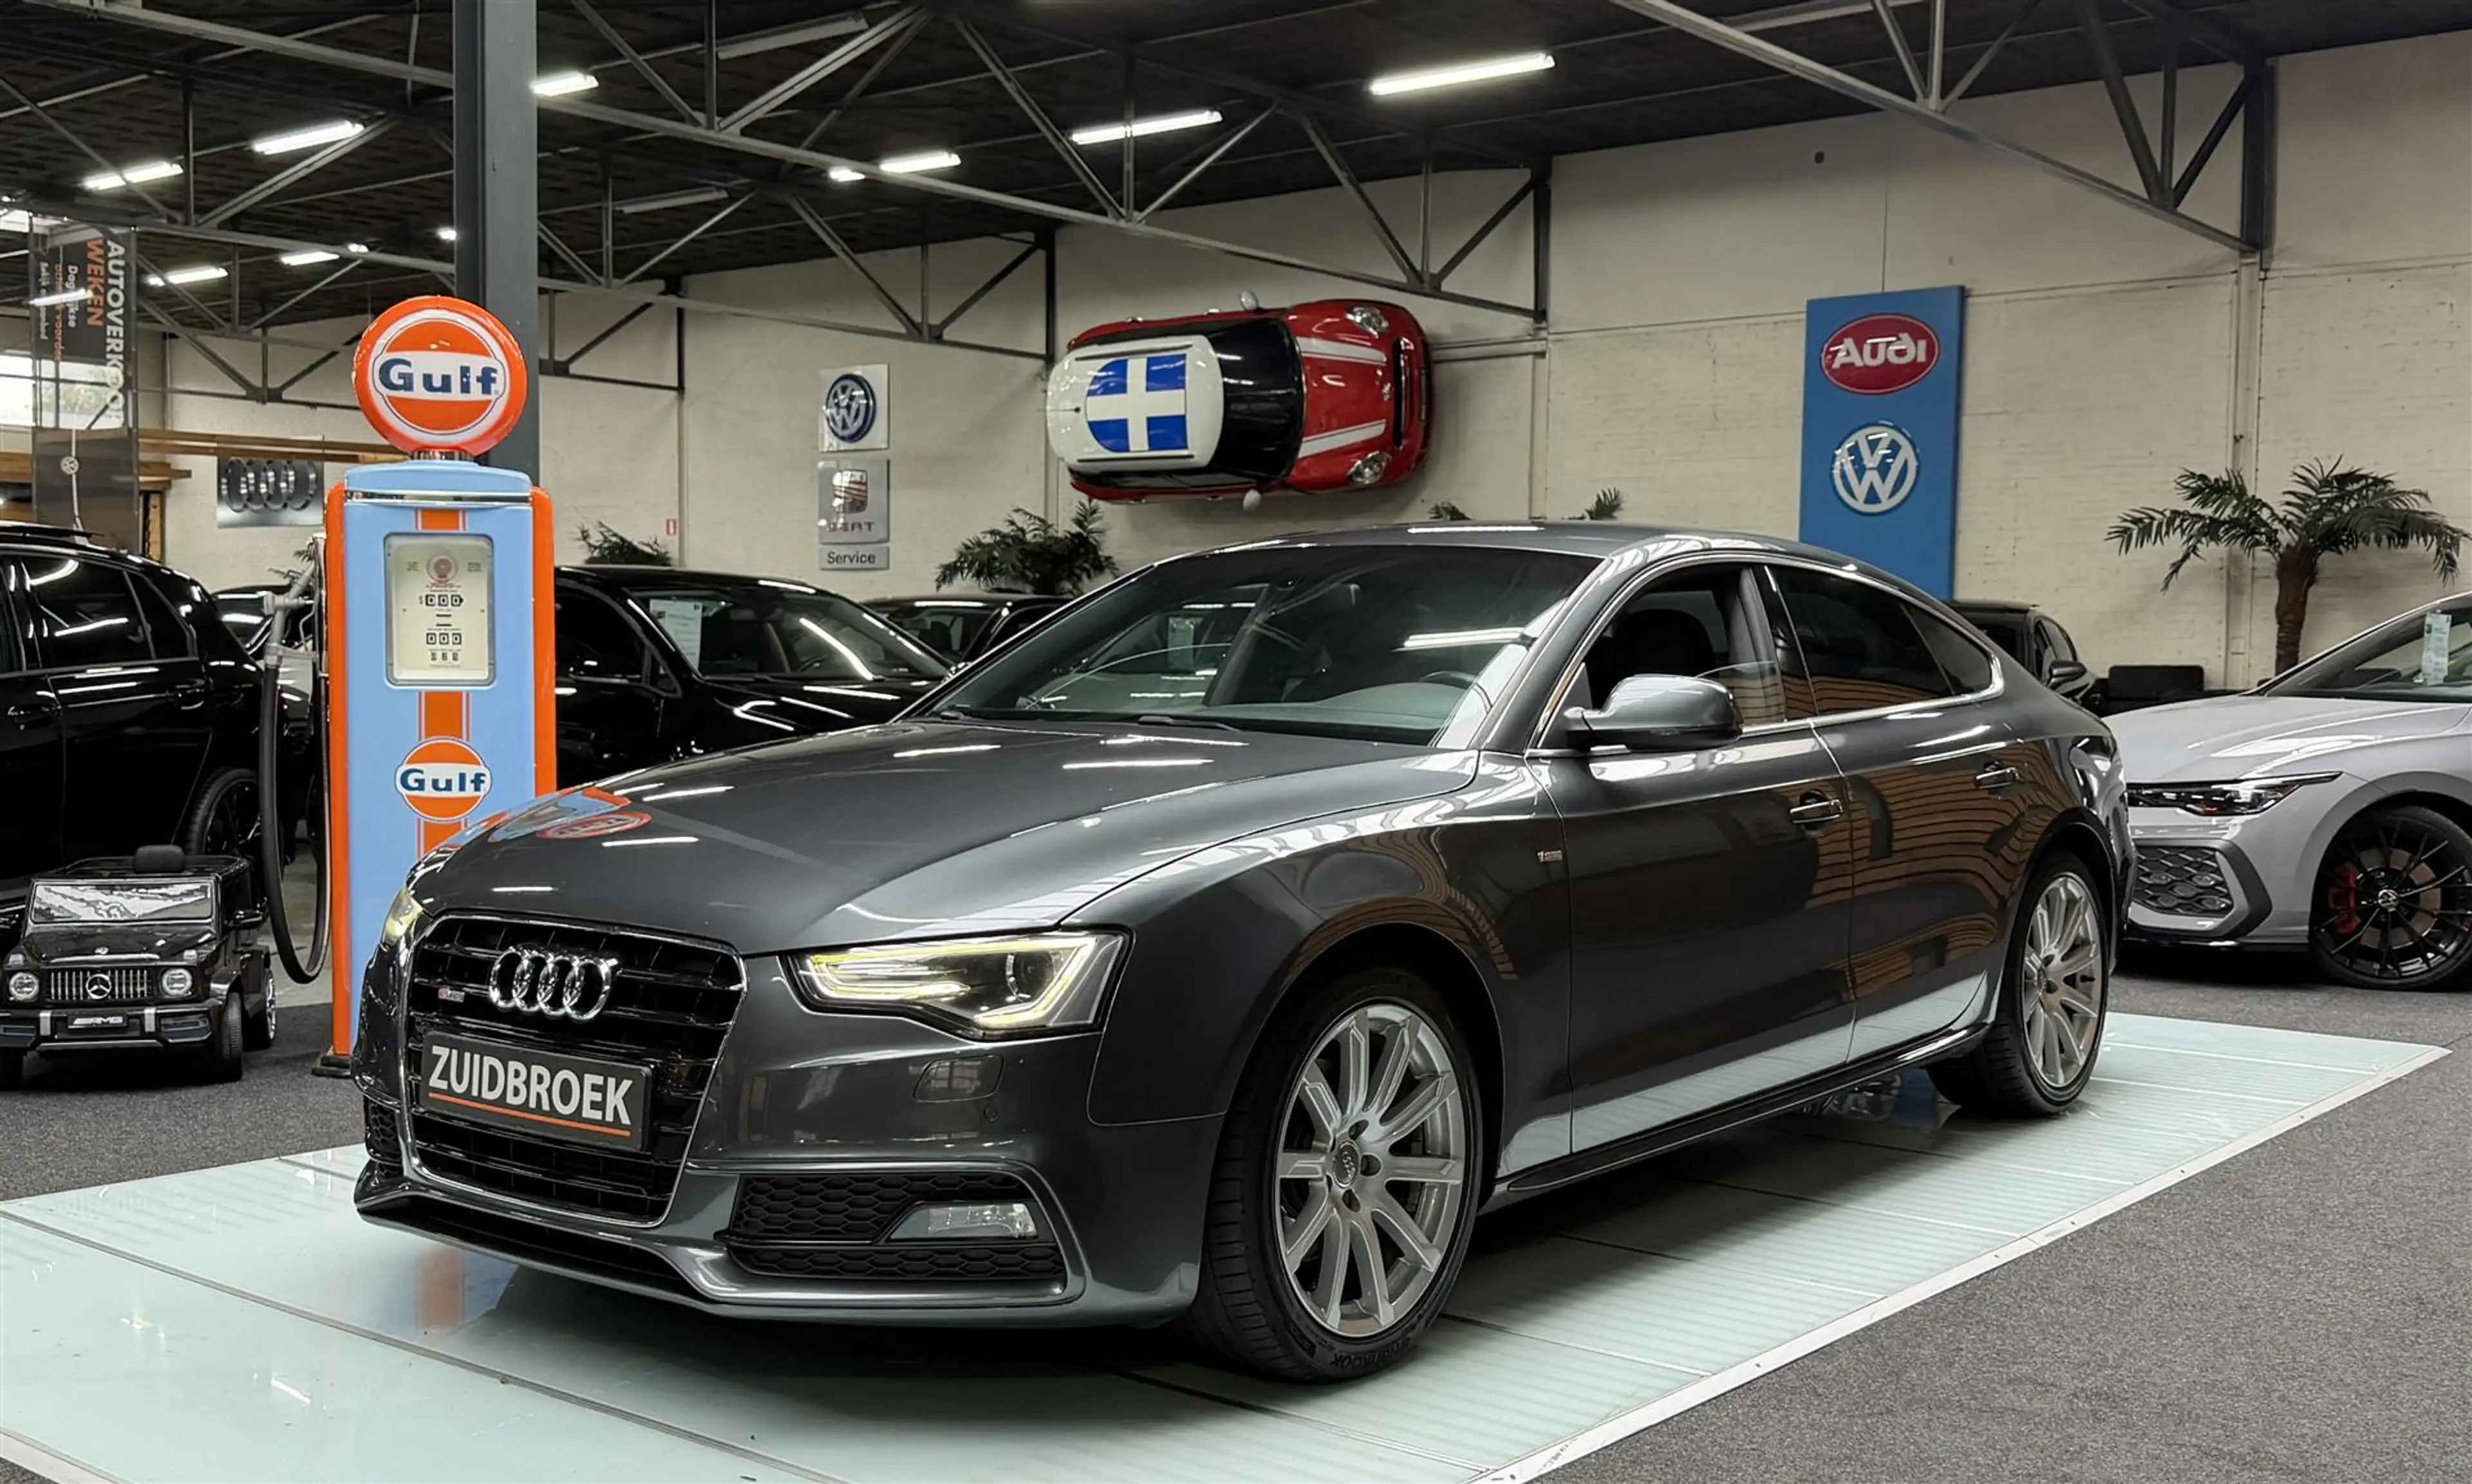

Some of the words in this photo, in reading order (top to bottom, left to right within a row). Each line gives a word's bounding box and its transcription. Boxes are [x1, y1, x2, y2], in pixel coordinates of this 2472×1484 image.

[86, 239, 104, 326] WEKEN
[379, 358, 498, 394] Gulf
[827, 551, 876, 564] Service
[400, 768, 486, 792] Gulf
[429, 1045, 633, 1125] ZUIDBROEK
